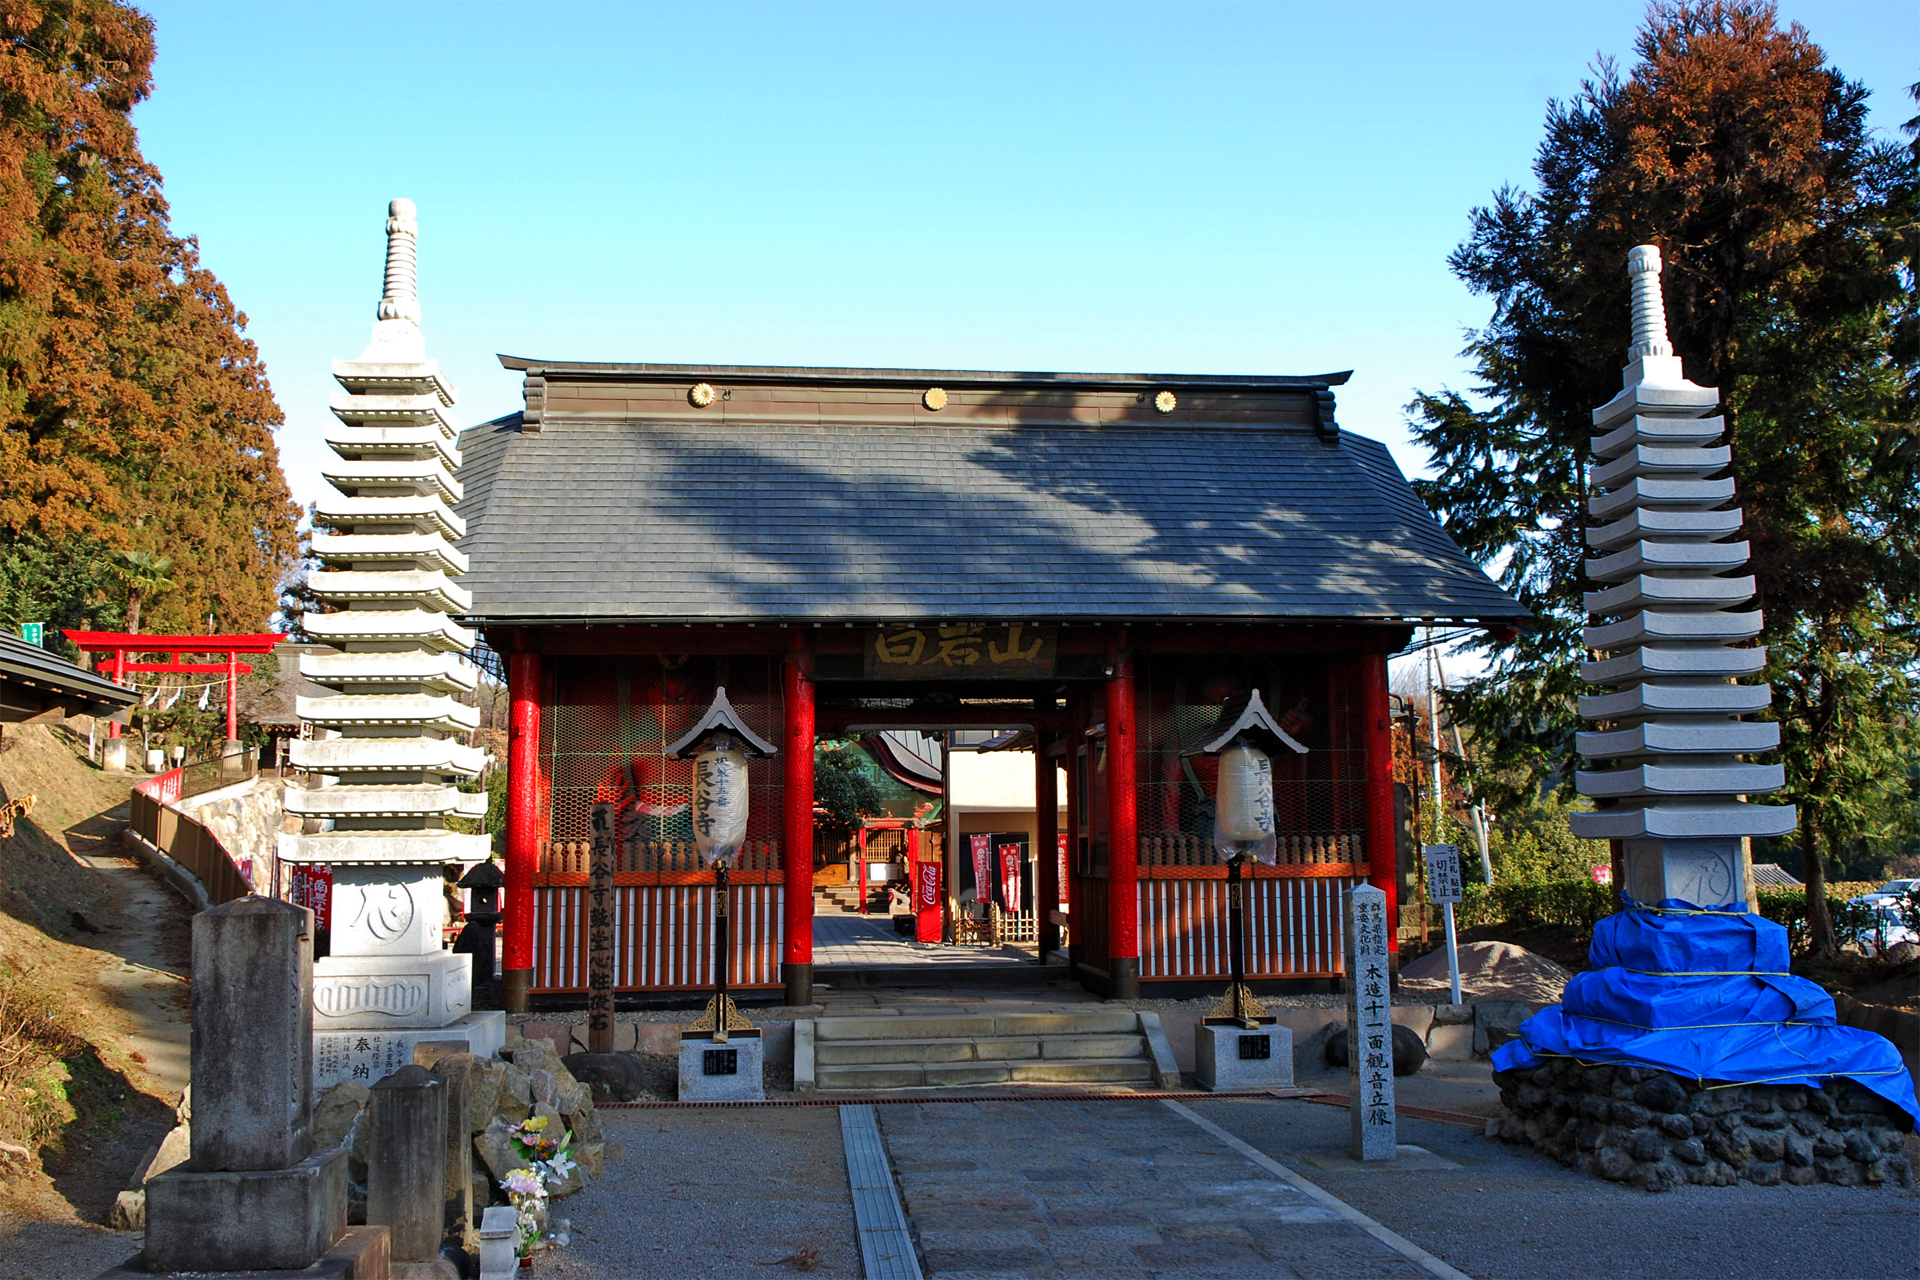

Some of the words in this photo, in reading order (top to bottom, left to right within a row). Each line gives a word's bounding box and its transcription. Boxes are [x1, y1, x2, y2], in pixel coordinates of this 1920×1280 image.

[875, 622, 1044, 666] 白岩山
[695, 760, 717, 838] 長谷寺
[1254, 758, 1273, 833] 長谷寺
[922, 863, 937, 905] Coca-Cola
[1435, 851, 1451, 897] 一切禁止
[1357, 902, 1371, 955] 重要文化財
[1371, 902, 1386, 955] 群馬県指定
[352, 1036, 372, 1080] 奉納
